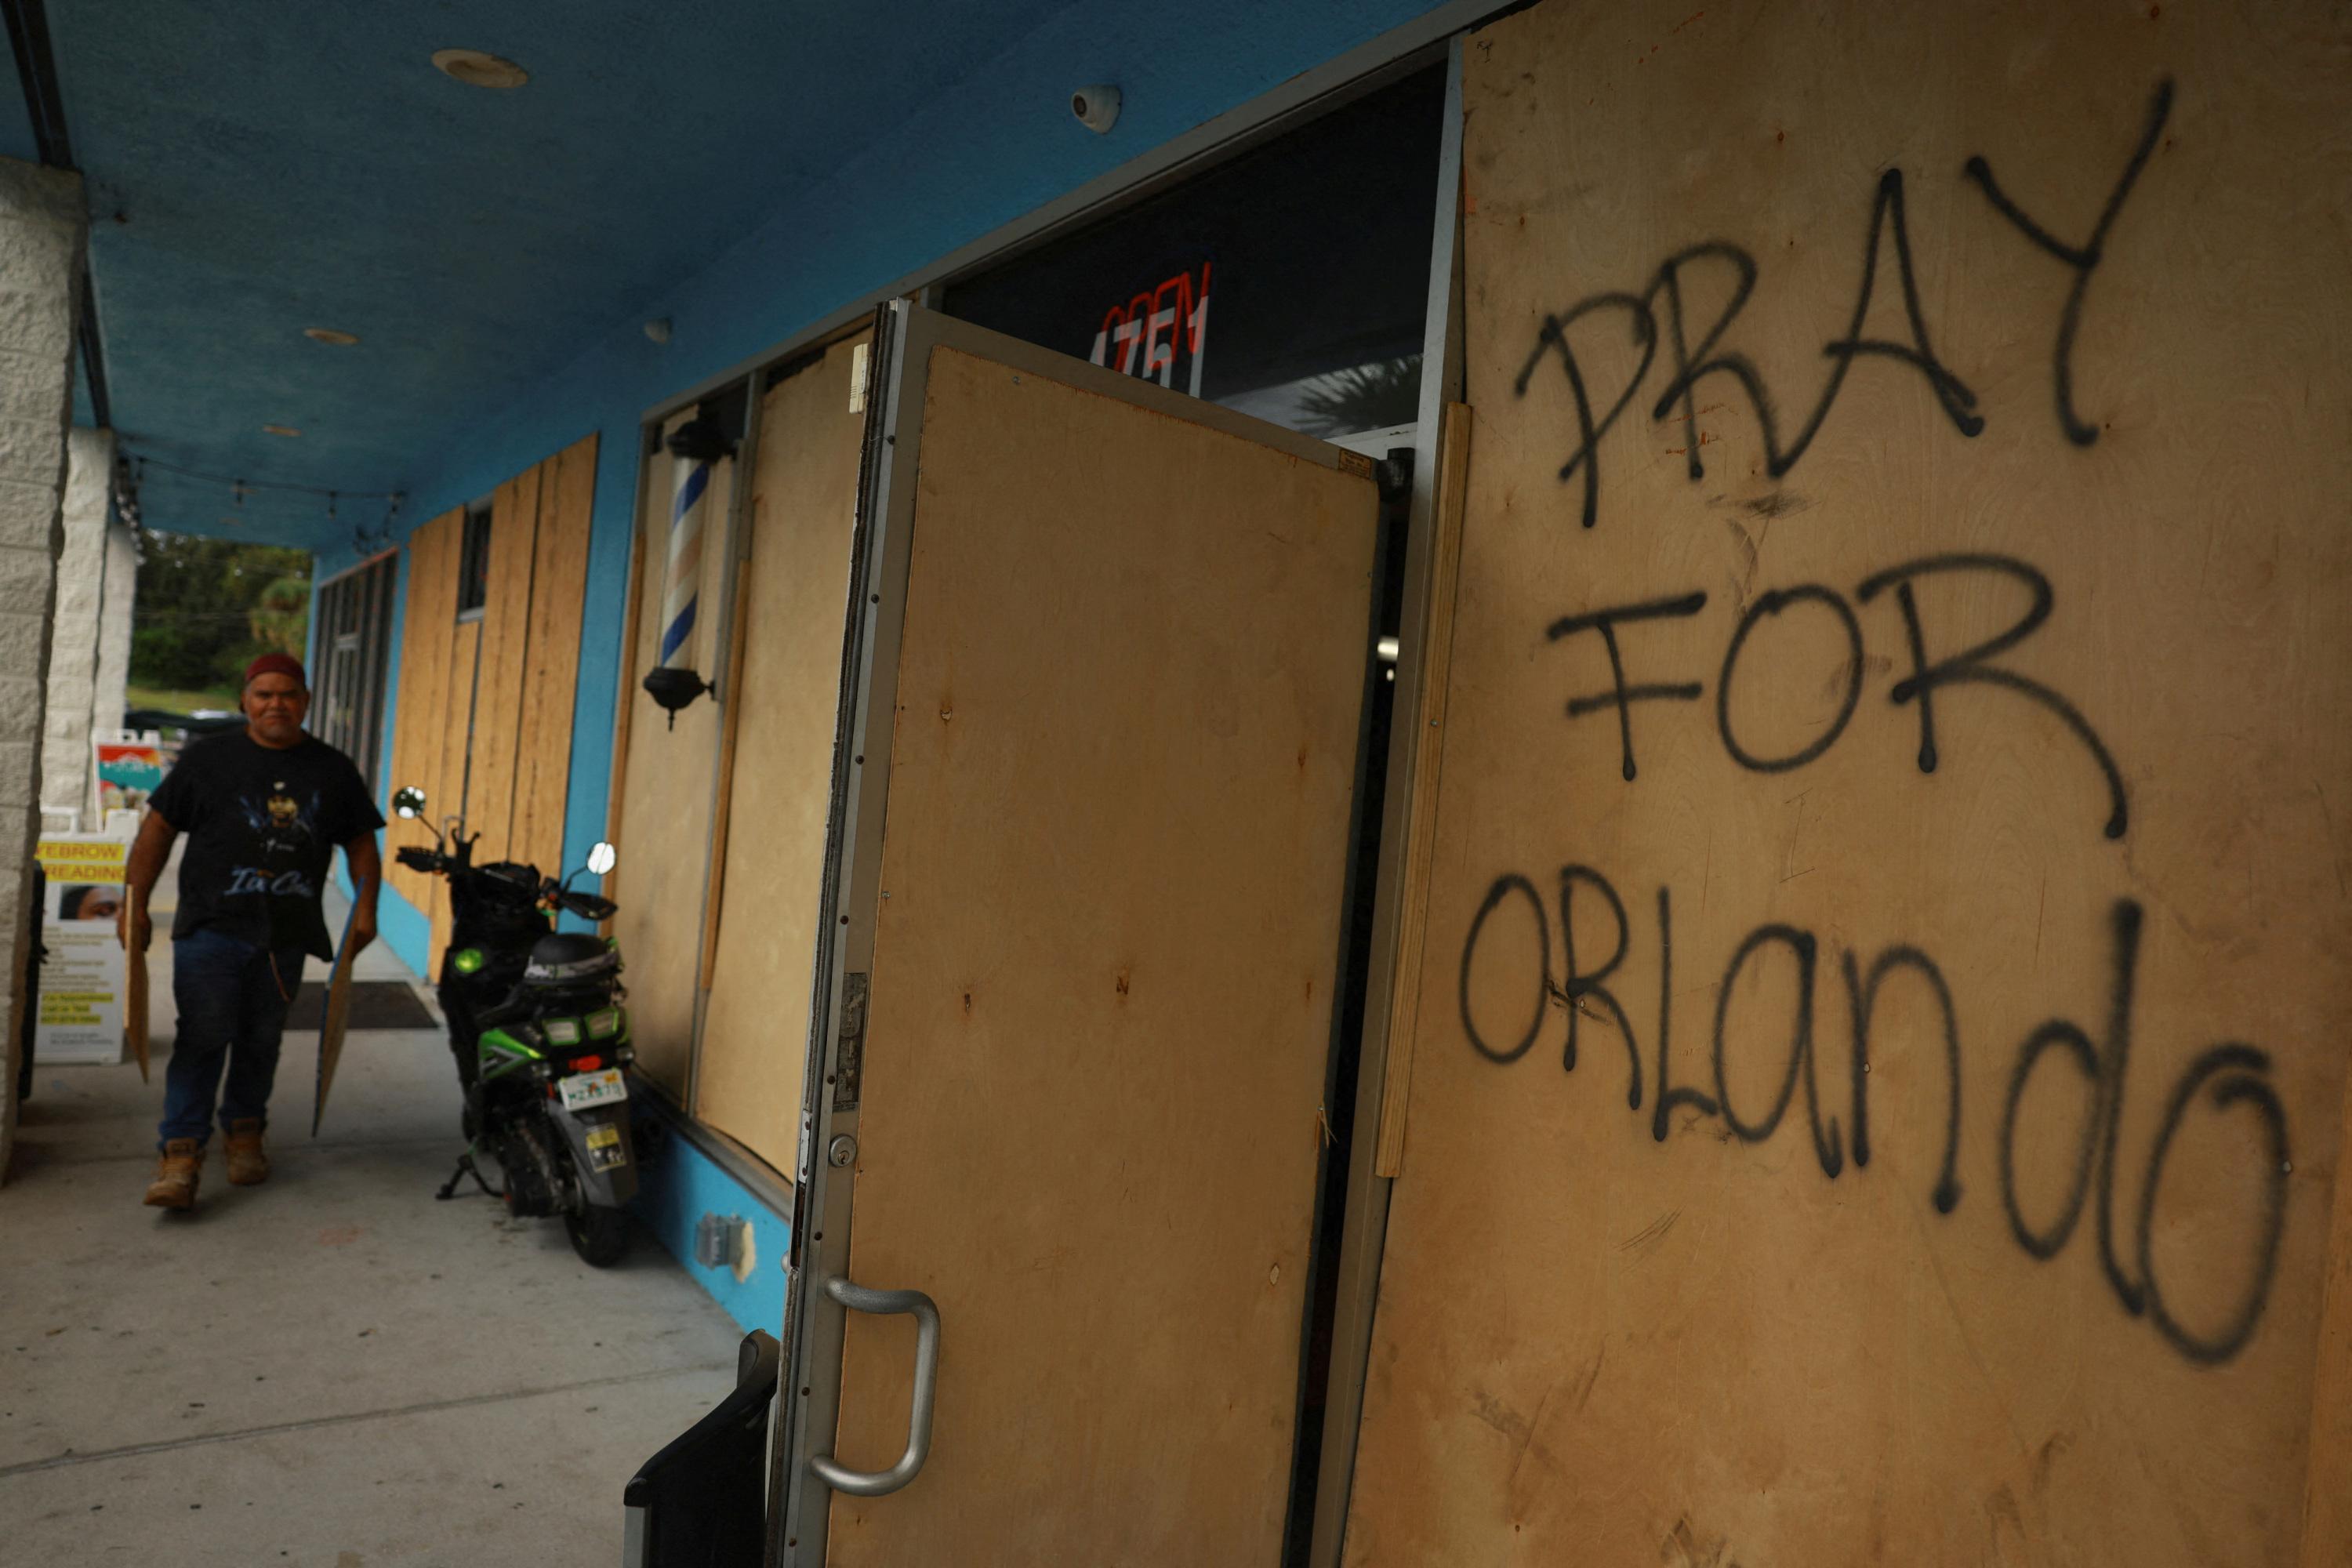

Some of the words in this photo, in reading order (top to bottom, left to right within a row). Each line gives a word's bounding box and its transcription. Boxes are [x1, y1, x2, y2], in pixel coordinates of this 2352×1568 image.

[1102, 261, 1212, 372] OPEN
[1514, 73, 2176, 528] PRAY
[1545, 552, 2128, 839] FOR
